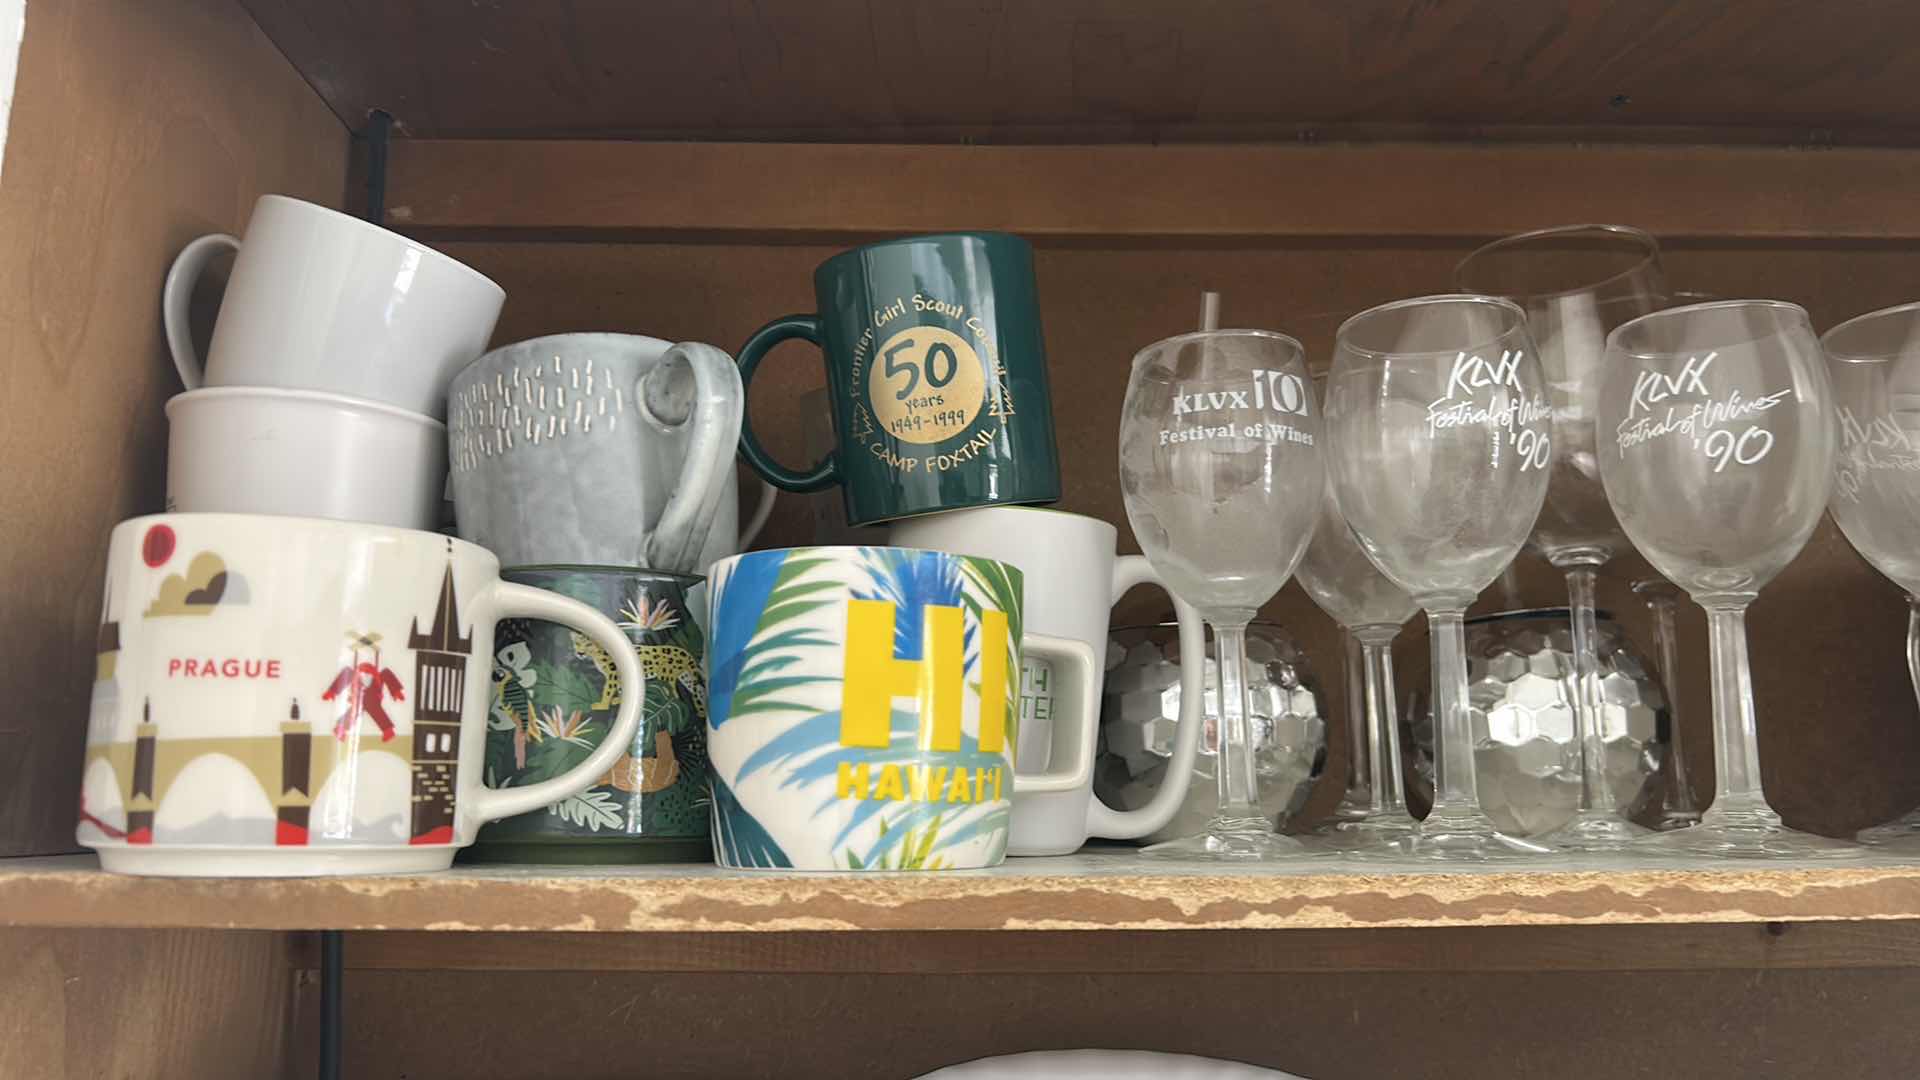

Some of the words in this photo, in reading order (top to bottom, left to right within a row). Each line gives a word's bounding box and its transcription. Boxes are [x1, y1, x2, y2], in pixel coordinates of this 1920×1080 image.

[850, 328, 873, 398] Frontier
[875, 298, 906, 327] Girl
[912, 294, 963, 319] Scout
[965, 317, 1007, 375] Coil
[884, 338, 958, 400] 50
[1447, 350, 1523, 399] KLVX
[1629, 352, 1718, 419] KLVX
[891, 409, 965, 434] 1949-1999
[905, 394, 944, 414] years
[1172, 391, 1249, 416] KLVX
[1425, 395, 1499, 439] Festival
[1500, 398, 1519, 432] of
[1616, 408, 1678, 460] Festival
[1680, 404, 1702, 438] of
[1702, 389, 1791, 429] Wines
[870, 442, 917, 472] CAMP
[926, 428, 997, 473] FOXTAIL
[1159, 423, 1235, 446] Festival
[1244, 424, 1264, 438] of
[1268, 423, 1313, 446] Wines
[1509, 429, 1551, 471] '90
[1693, 426, 1773, 472] '90
[168, 658, 281, 678] PRAGUE
[839, 599, 1009, 753] HI
